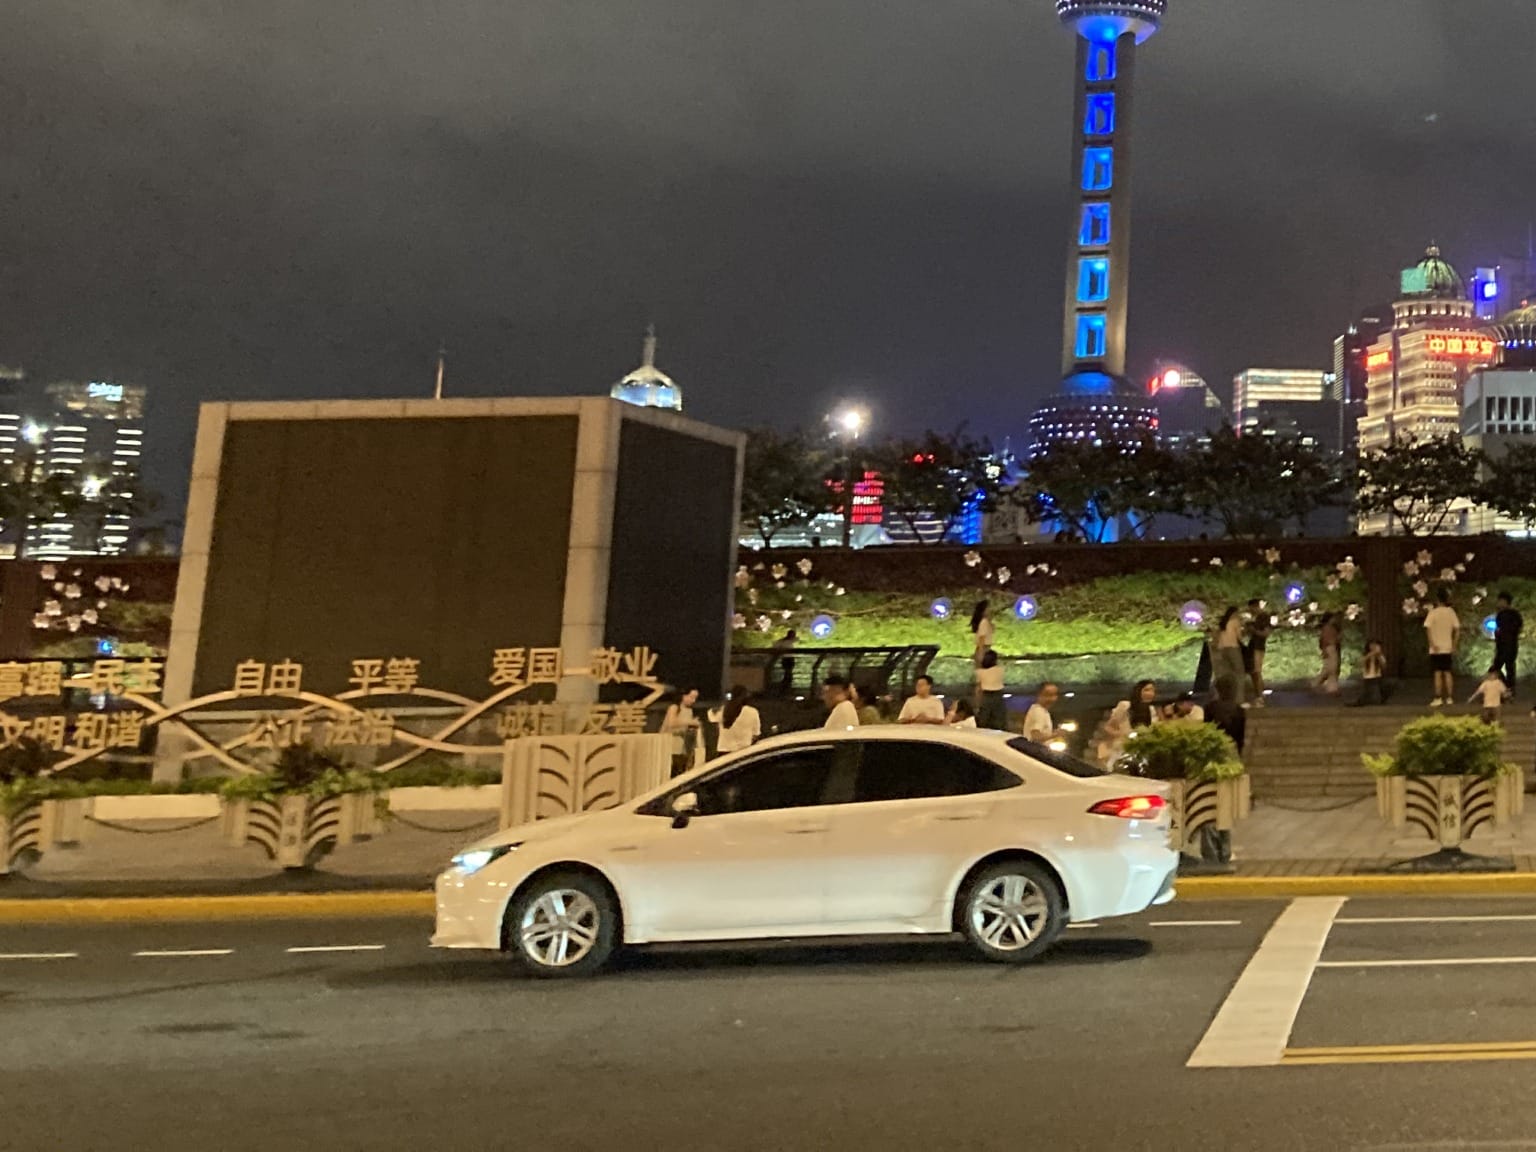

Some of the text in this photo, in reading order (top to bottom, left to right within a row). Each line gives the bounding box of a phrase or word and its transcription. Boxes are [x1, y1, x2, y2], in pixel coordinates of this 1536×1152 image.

[92, 658, 163, 696] 民主
[235, 659, 303, 695] 自由
[349, 658, 421, 694] 平等
[489, 647, 658, 686] 爱国 敬业
[0, 712, 145, 749] 文明 和谐
